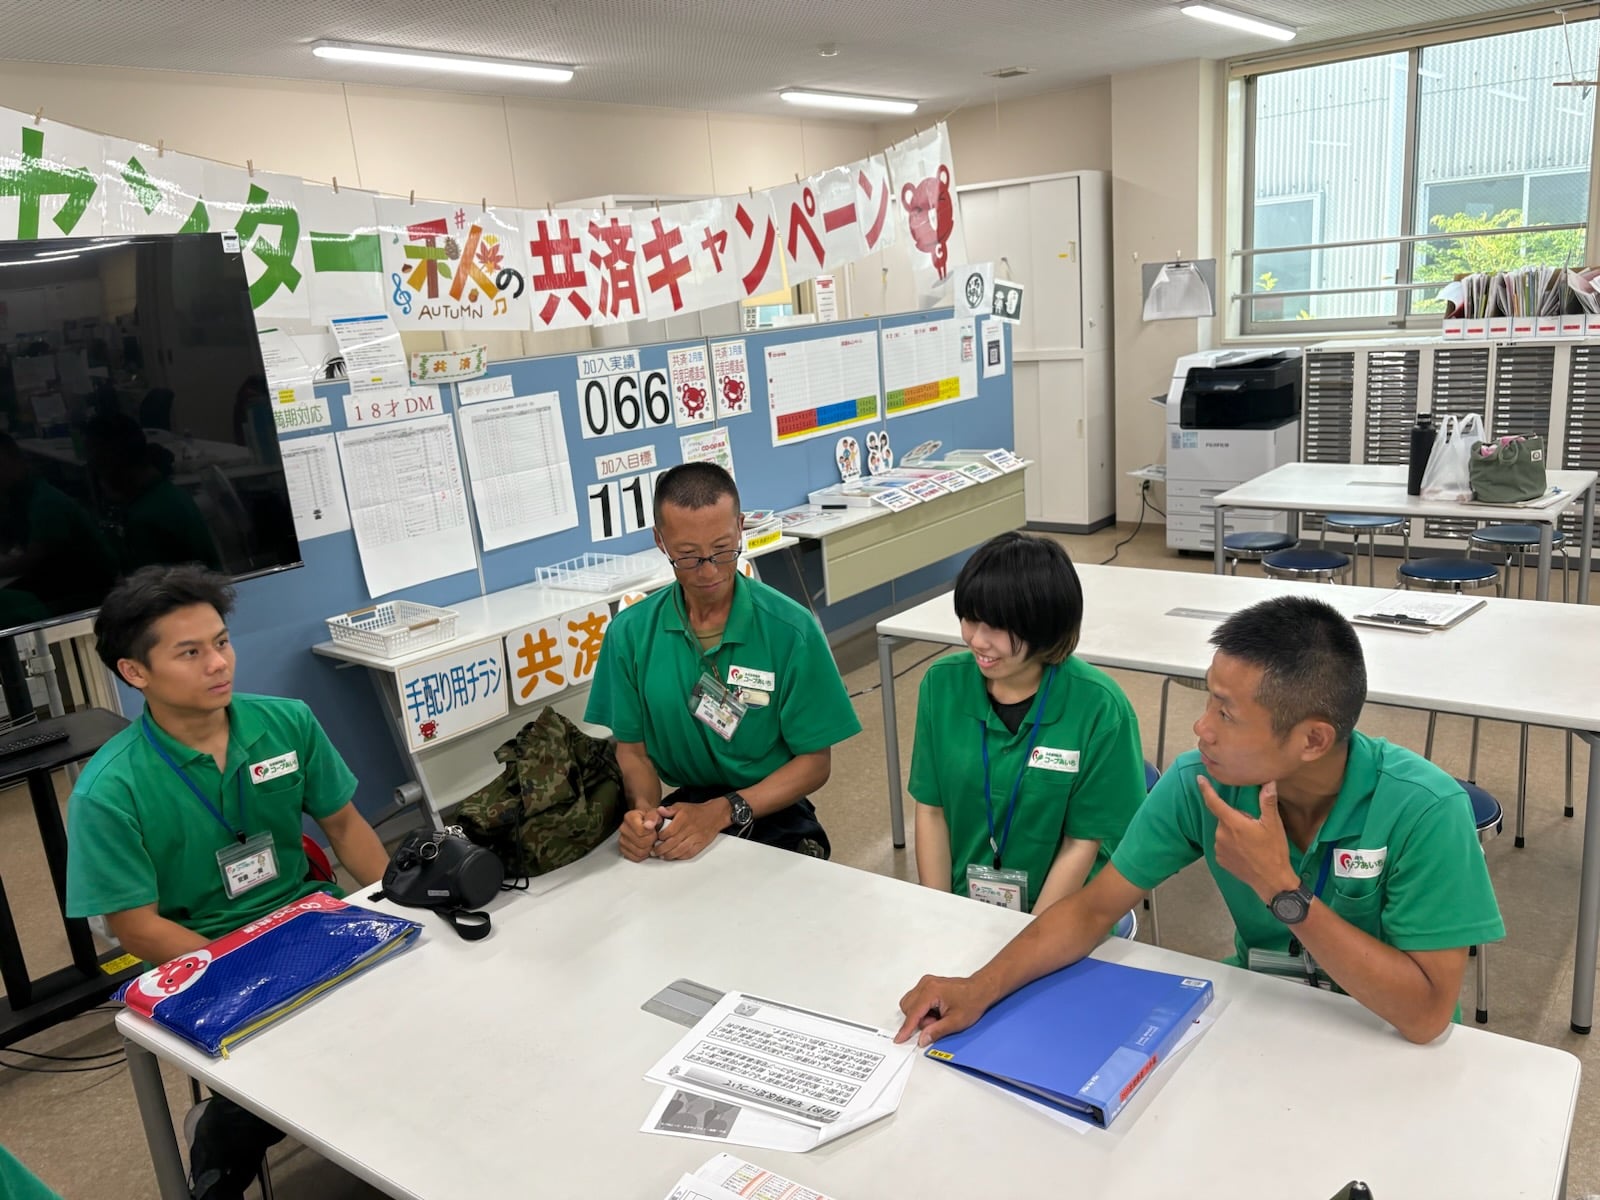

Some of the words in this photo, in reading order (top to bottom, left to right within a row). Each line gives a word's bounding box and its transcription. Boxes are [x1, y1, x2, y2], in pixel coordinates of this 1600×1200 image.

[530, 168, 889, 326] 共済キャンペーン
[418, 304, 484, 321] AUTUMN
[433, 356, 471, 373] 共済
[582, 353, 636, 375] 加入実績
[584, 371, 670, 435] 066
[601, 450, 653, 476] 加入目標
[589, 476, 646, 538] 11
[404, 656, 502, 723] 手配り用チラシ
[1043, 755, 1077, 767] コープあいち
